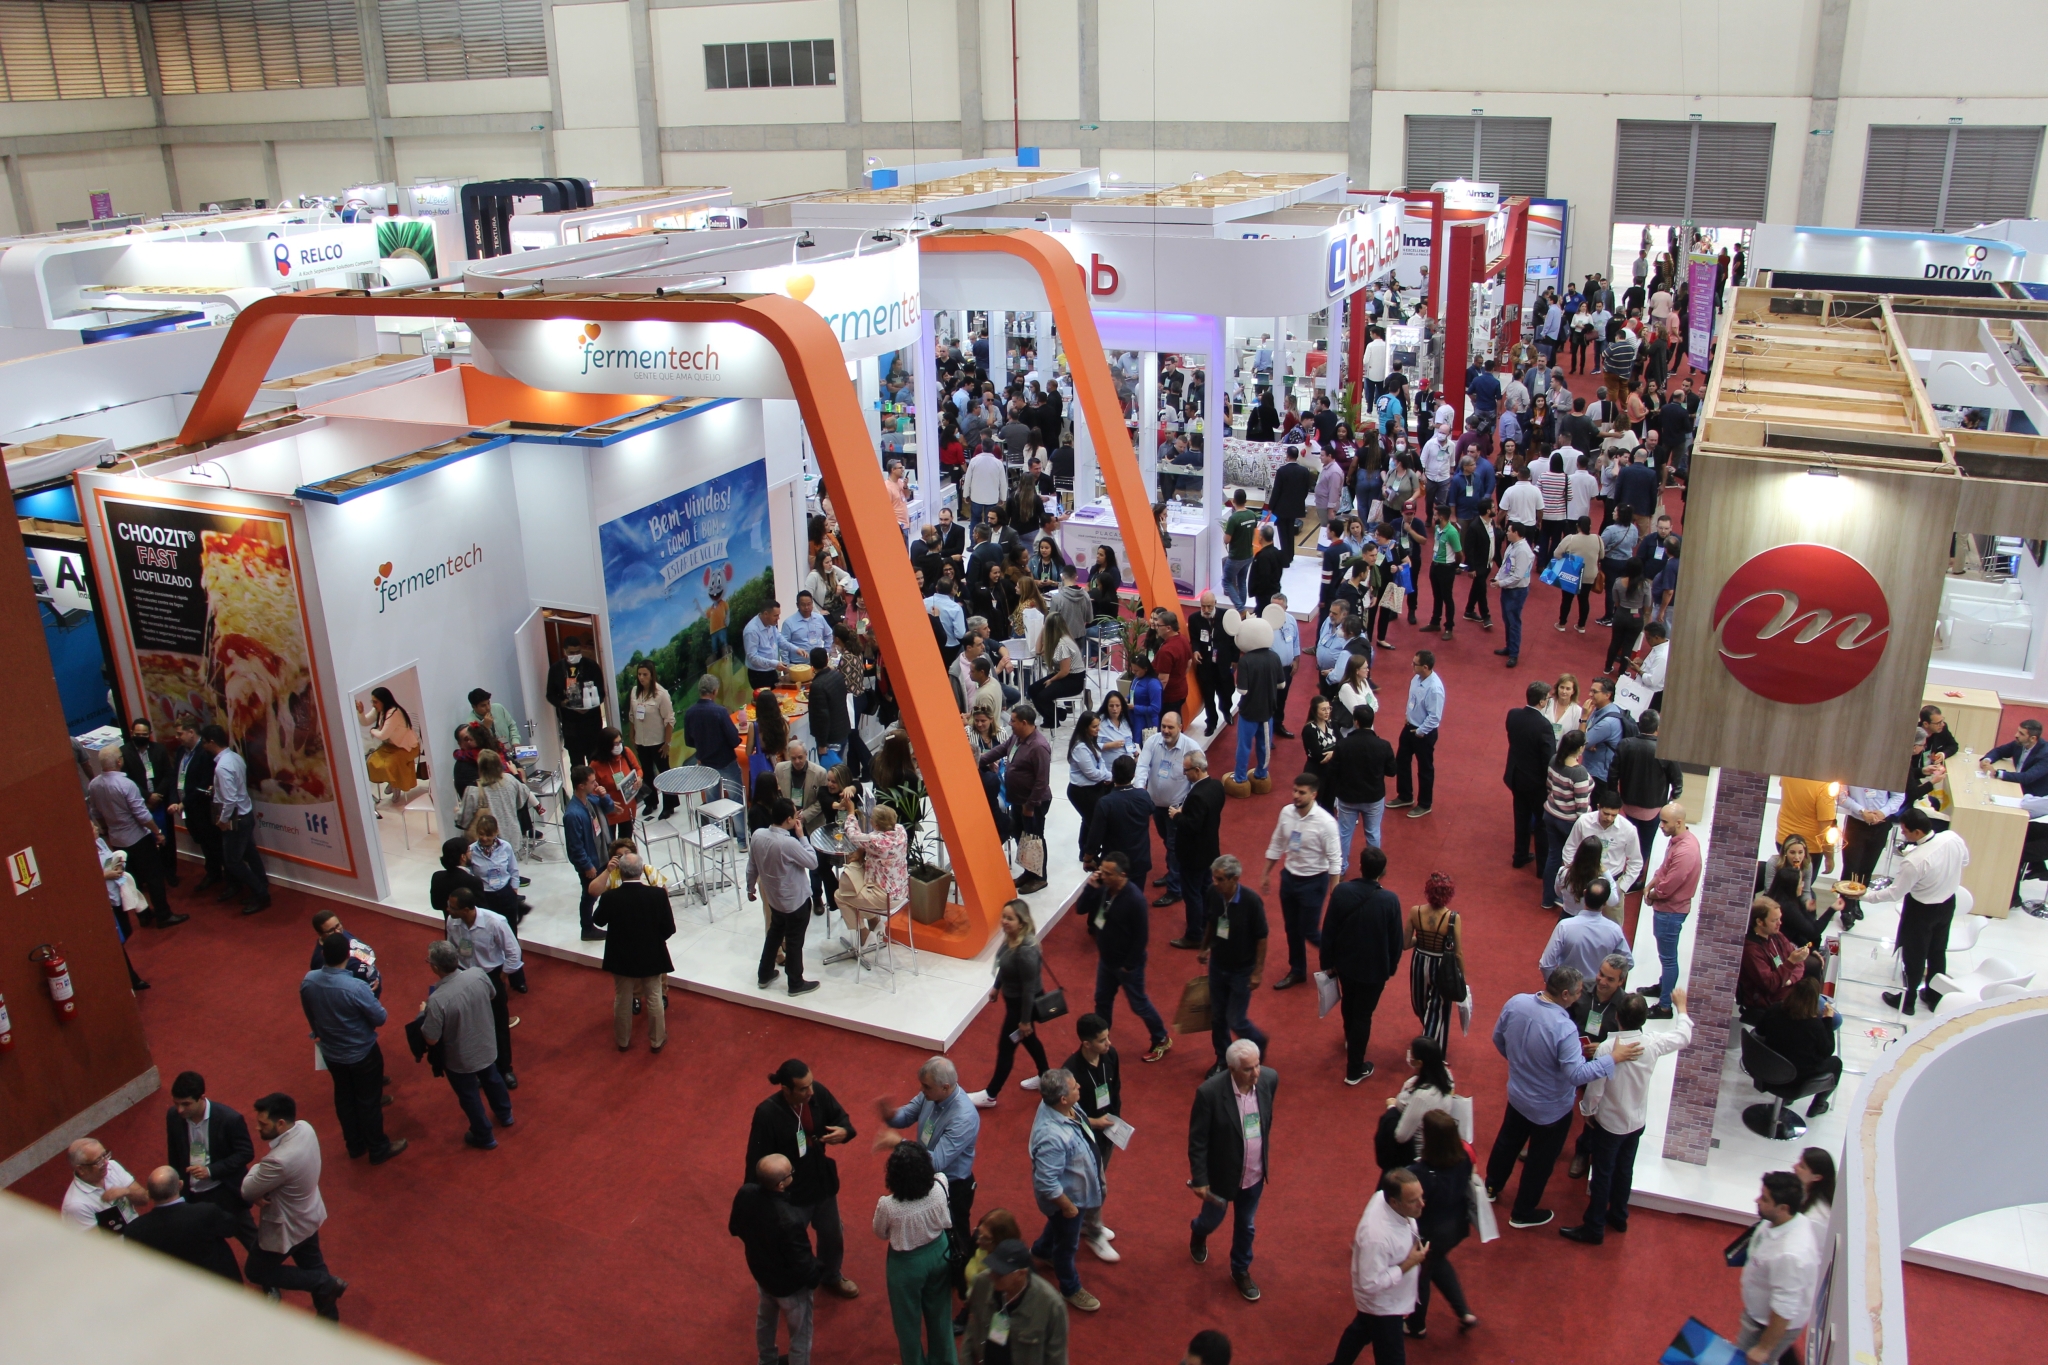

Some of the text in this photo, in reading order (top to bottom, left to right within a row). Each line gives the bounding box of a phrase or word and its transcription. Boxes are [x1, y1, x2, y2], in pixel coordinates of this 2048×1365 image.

[1466, 190, 1494, 198] Almac
[301, 244, 343, 265] RELCO
[581, 342, 719, 374] fermentech
[634, 372, 657, 380] GENTE
[659, 372, 674, 381] QUE
[667, 519, 719, 555] COMO É BOM
[136, 545, 178, 570] FAST
[666, 559, 690, 580] ESTAR
[690, 552, 699, 566] DE
[133, 569, 192, 588] LIOFILIZADO
[379, 543, 482, 613] fermentech
[1628, 692, 1640, 702] TCA
[305, 812, 328, 835] iff
